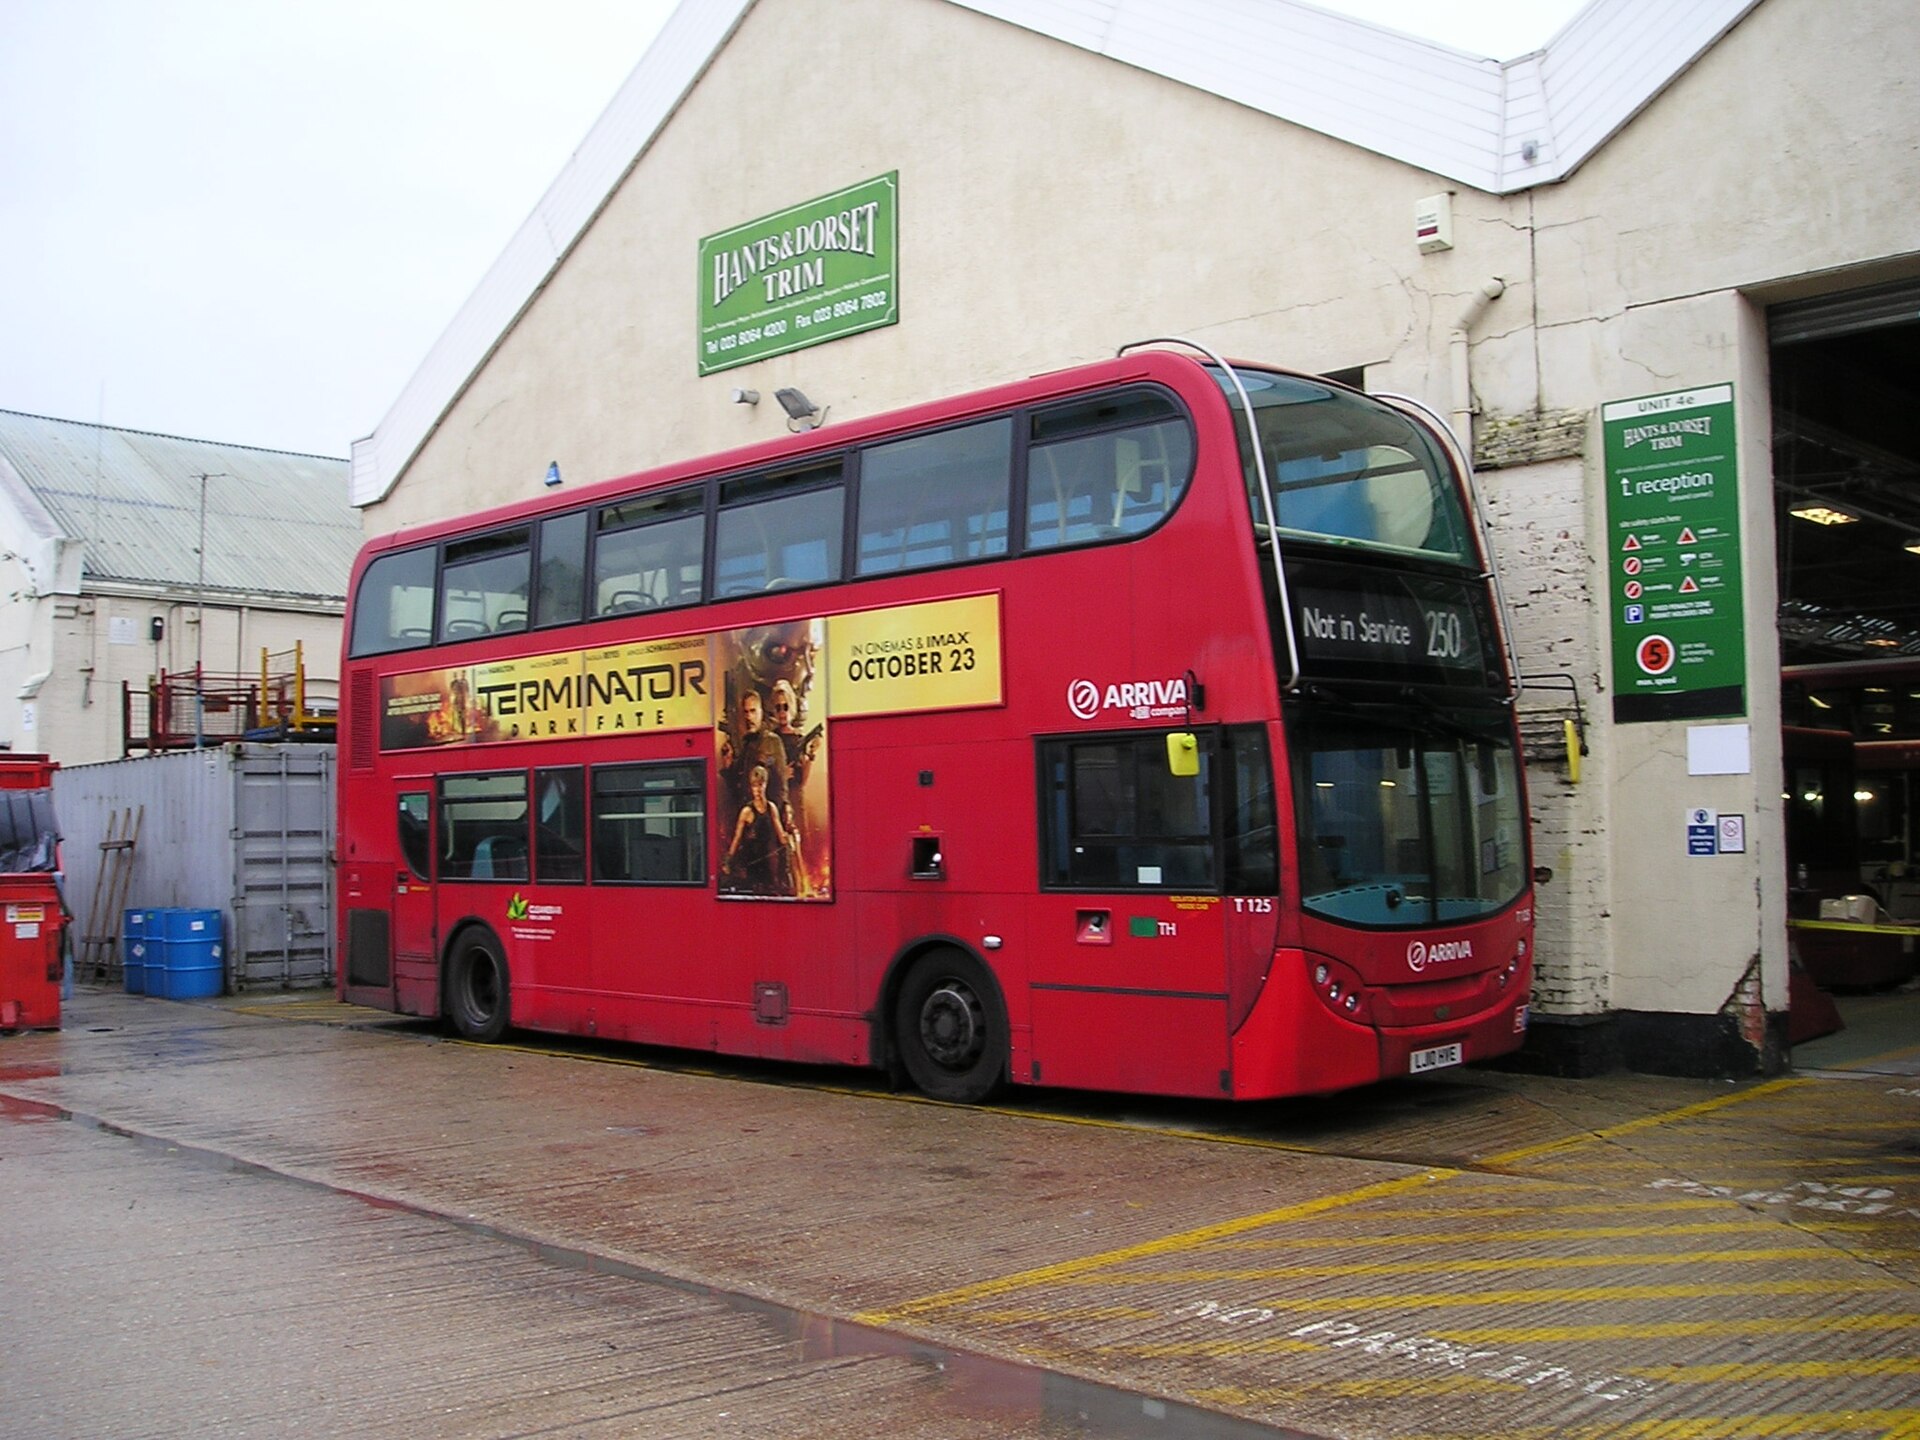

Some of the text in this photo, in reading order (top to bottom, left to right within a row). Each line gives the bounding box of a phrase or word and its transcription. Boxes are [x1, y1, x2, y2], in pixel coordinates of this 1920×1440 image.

[763, 258, 824, 302] TRIM
[795, 315, 812, 329] Fax
[1638, 398, 1671, 412] UNIT
[1650, 436, 1682, 450] TRIM
[1636, 472, 1713, 494] reception
[851, 632, 970, 656] IN CINEMAS & IMAX
[1303, 607, 1460, 658] Not in Service 250
[849, 647, 976, 681] OCTOBER 23
[1648, 643, 1663, 665] 5
[477, 659, 706, 717] TERMINATOR
[1103, 679, 1186, 708] ARRIVA
[510, 709, 664, 738] DARK FATE
[1158, 922, 1177, 936] TH
[1427, 940, 1472, 963] ARRIVA
